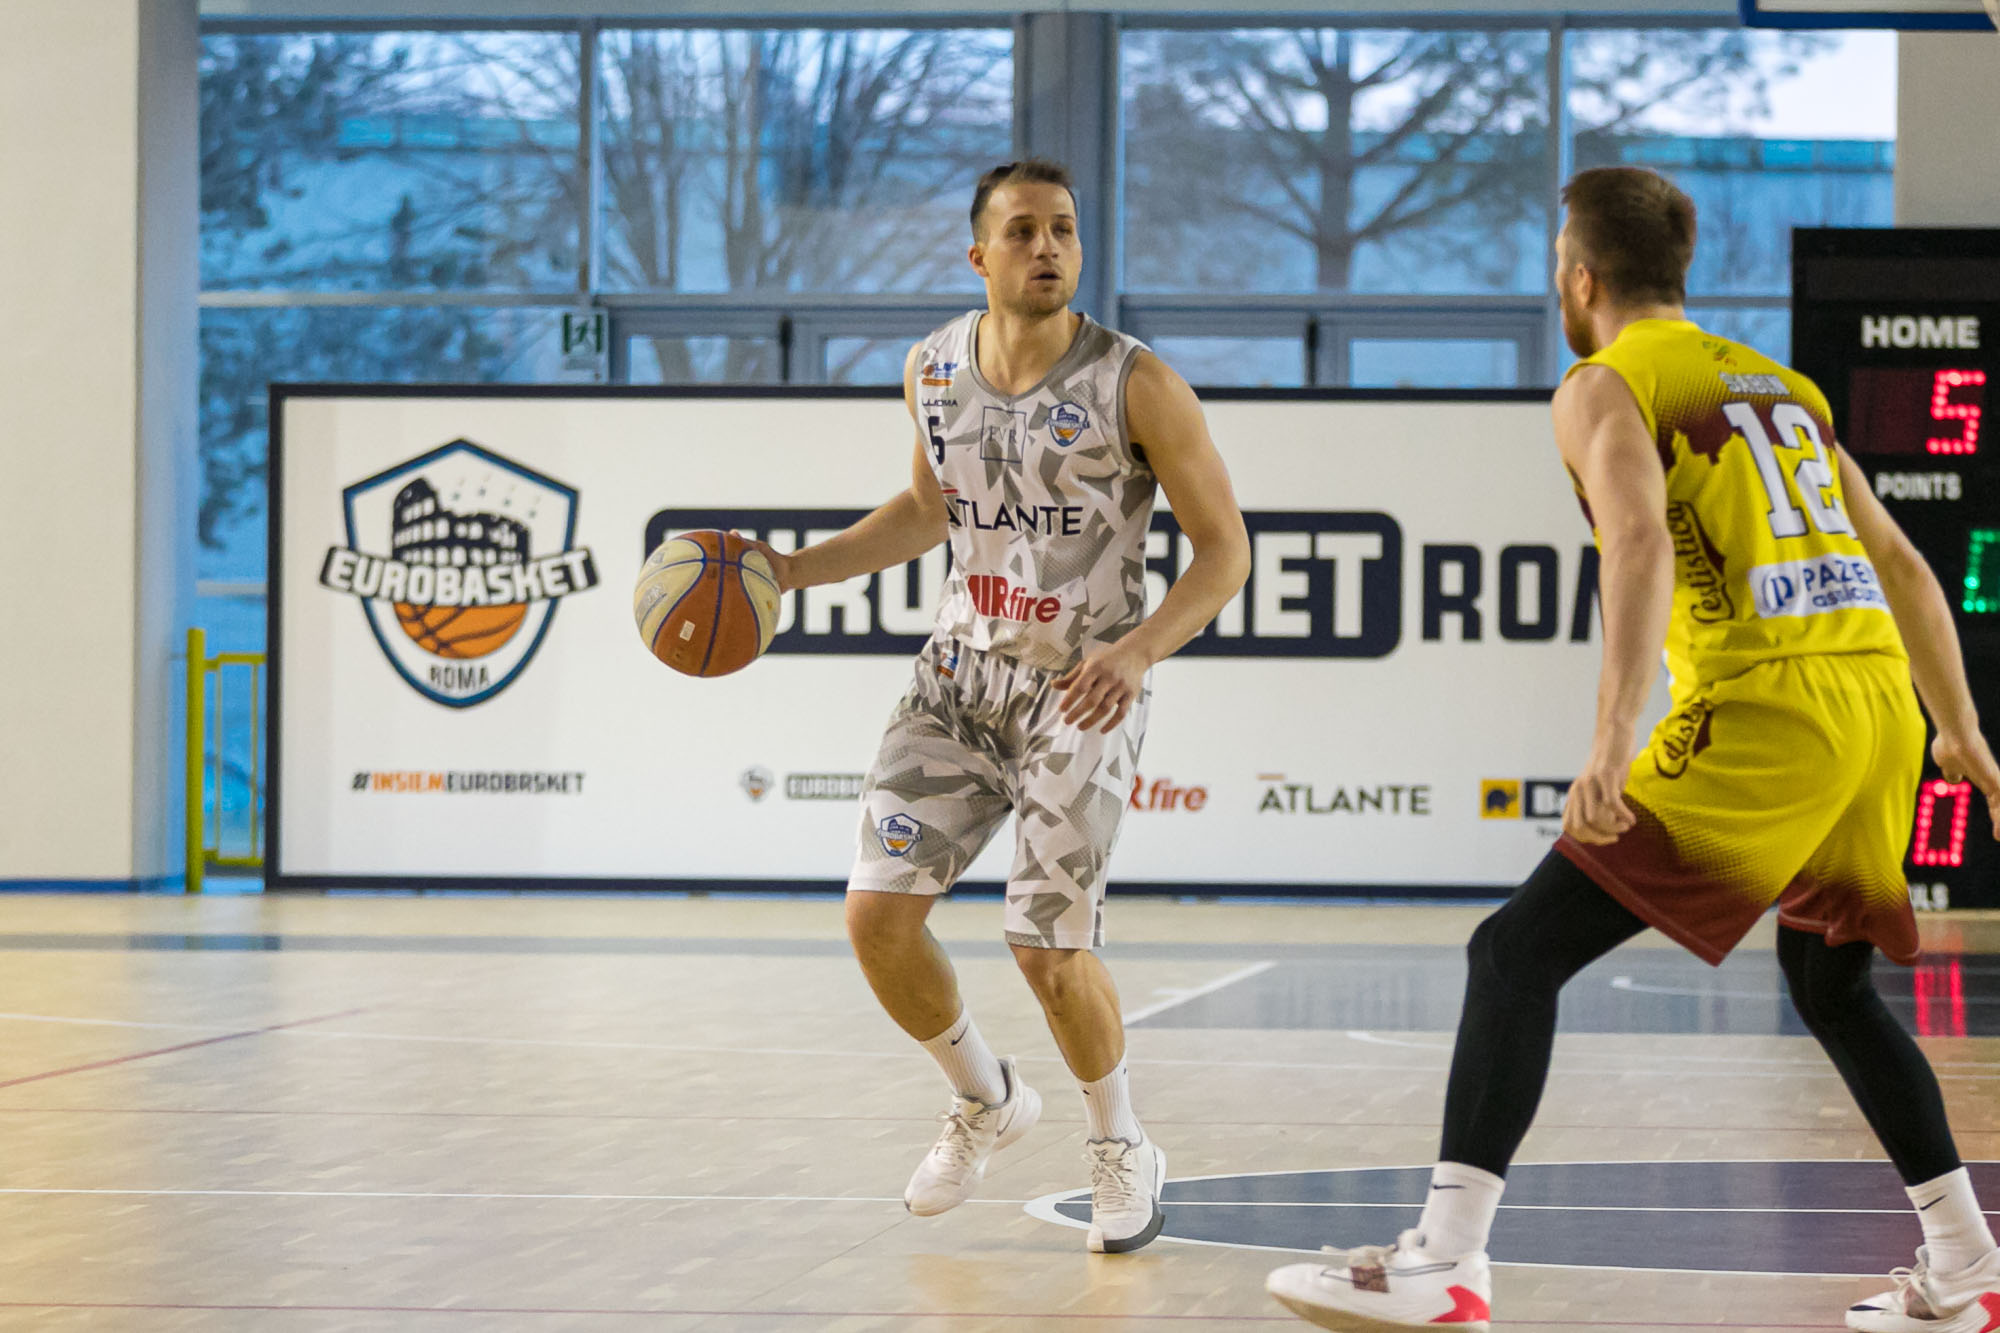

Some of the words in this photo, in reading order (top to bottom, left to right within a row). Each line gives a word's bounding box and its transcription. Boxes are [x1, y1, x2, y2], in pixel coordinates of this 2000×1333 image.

[1861, 315, 1981, 349] HOME
[1926, 369, 1987, 455] 5
[1721, 400, 1858, 540] 12
[1875, 472, 1963, 500] POINTS
[327, 550, 592, 608] EUROBASKET
[429, 664, 491, 691] ROMA
[1258, 785, 1432, 814] ATLANTE
[1912, 779, 1973, 868] 0
